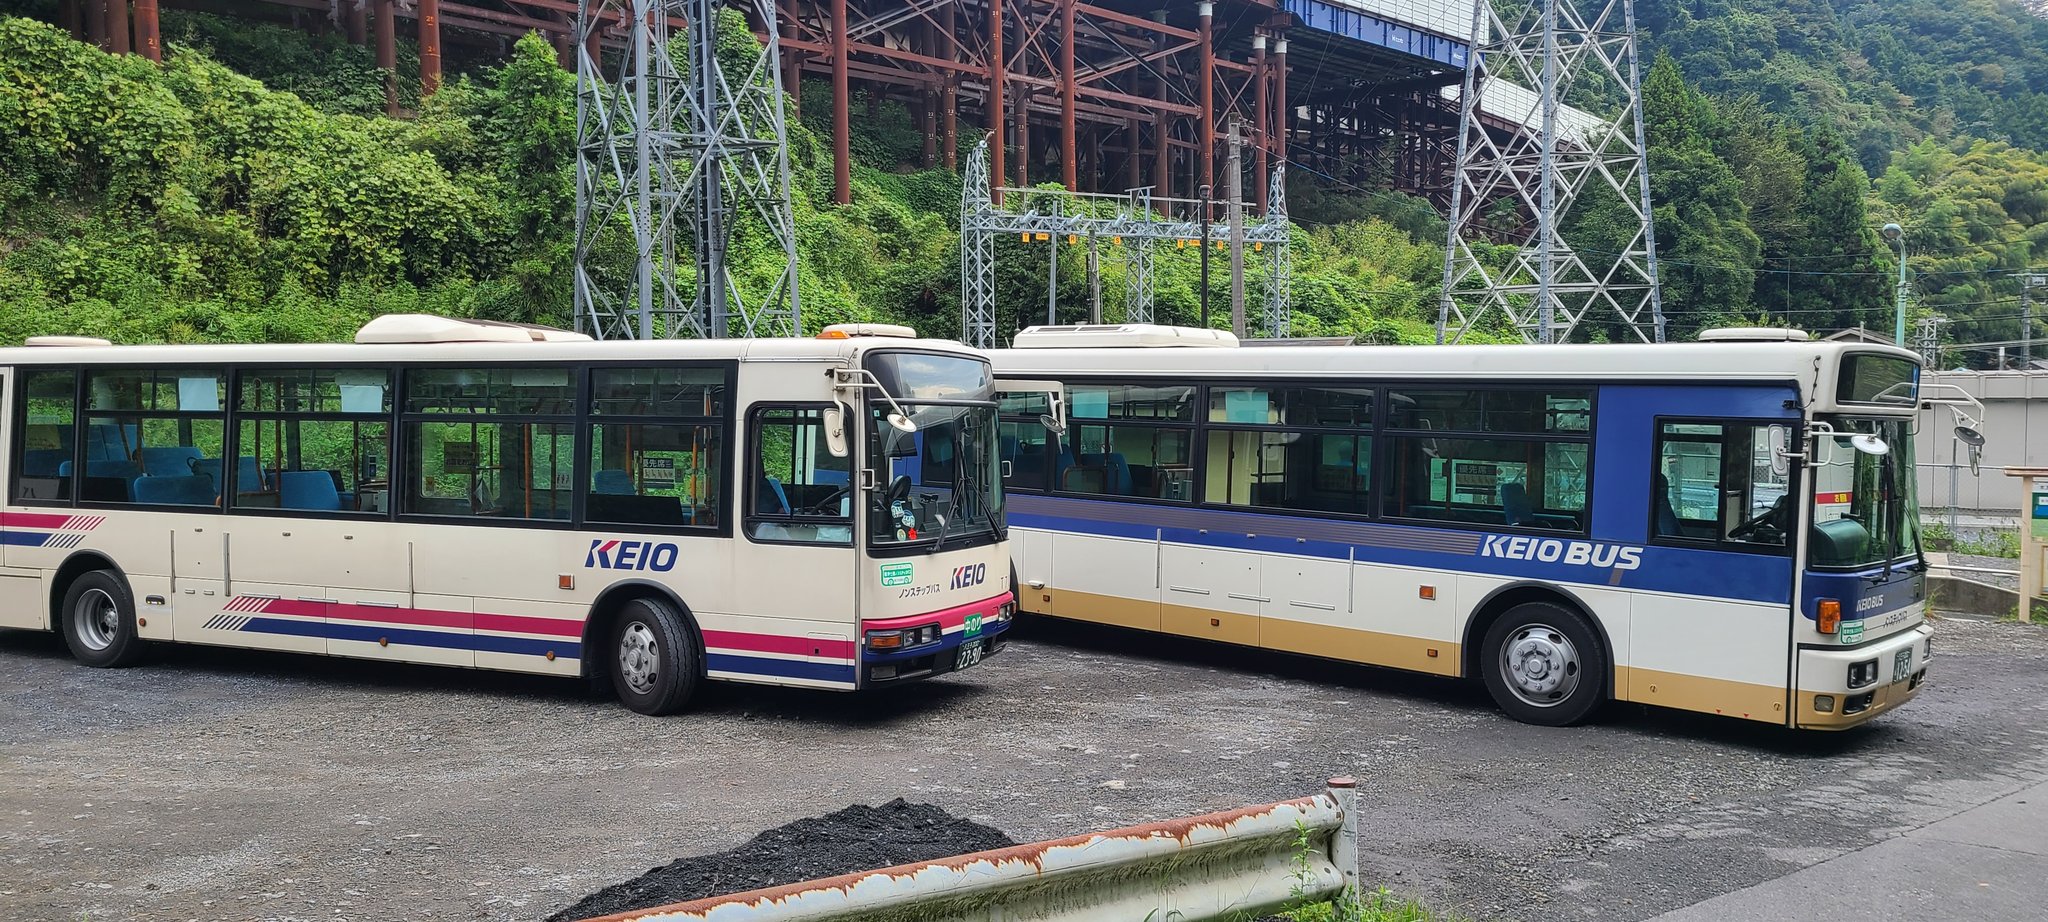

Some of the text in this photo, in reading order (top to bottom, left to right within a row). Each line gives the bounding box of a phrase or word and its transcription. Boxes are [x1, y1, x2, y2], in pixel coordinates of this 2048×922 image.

[585, 539, 679, 572] KEIO
[1481, 534, 1644, 570] KEIO BUS
[950, 562, 986, 590] KEIO
[898, 583, 941, 598] ノンステップバス
[1856, 594, 1884, 612] KEIO BUS
[964, 616, 982, 634] 中のり
